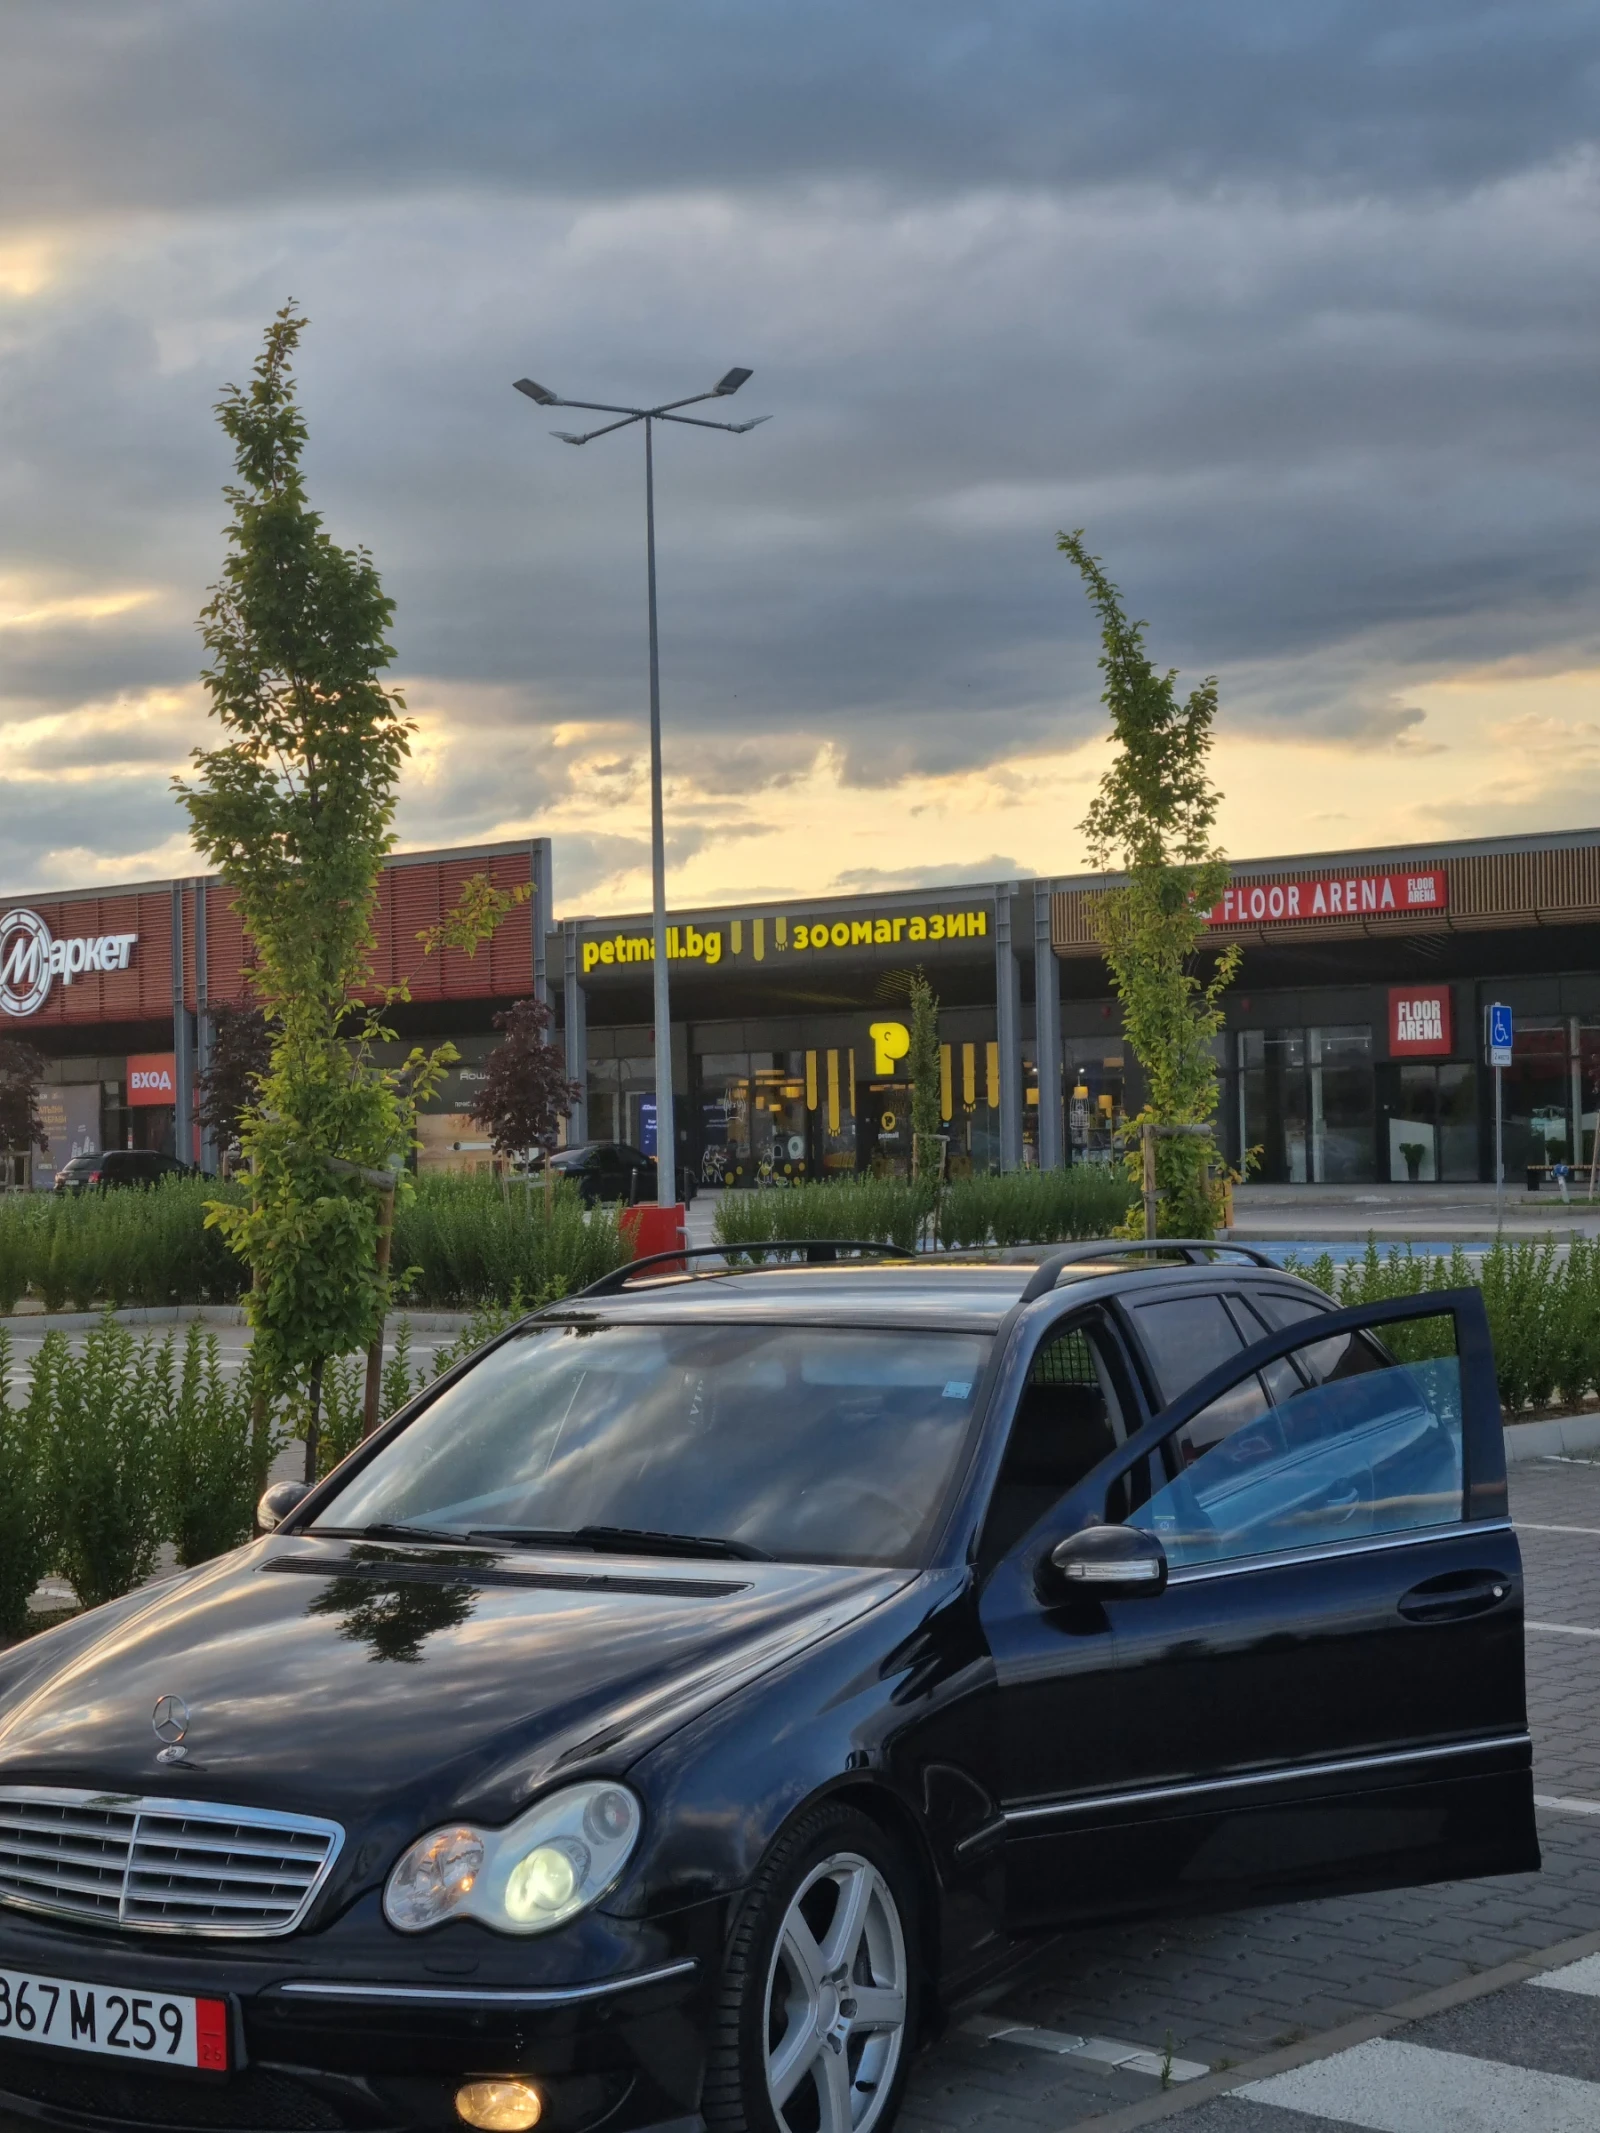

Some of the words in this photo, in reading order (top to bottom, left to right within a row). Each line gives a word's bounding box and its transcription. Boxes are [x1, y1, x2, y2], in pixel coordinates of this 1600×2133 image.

[1407, 877, 1435, 890] FLOOR
[1224, 885, 1300, 920] FLOOR
[1312, 878, 1395, 915] ARENA
[1407, 889, 1436, 903] ARENA
[793, 911, 987, 950] зоомагазин
[1397, 1000, 1441, 1021] FLOOR
[1397, 1019, 1443, 1041] ARENA
[131, 1071, 172, 1090] ВХОД
[70, 1989, 96, 2043] M
[106, 1995, 183, 2055] 259
